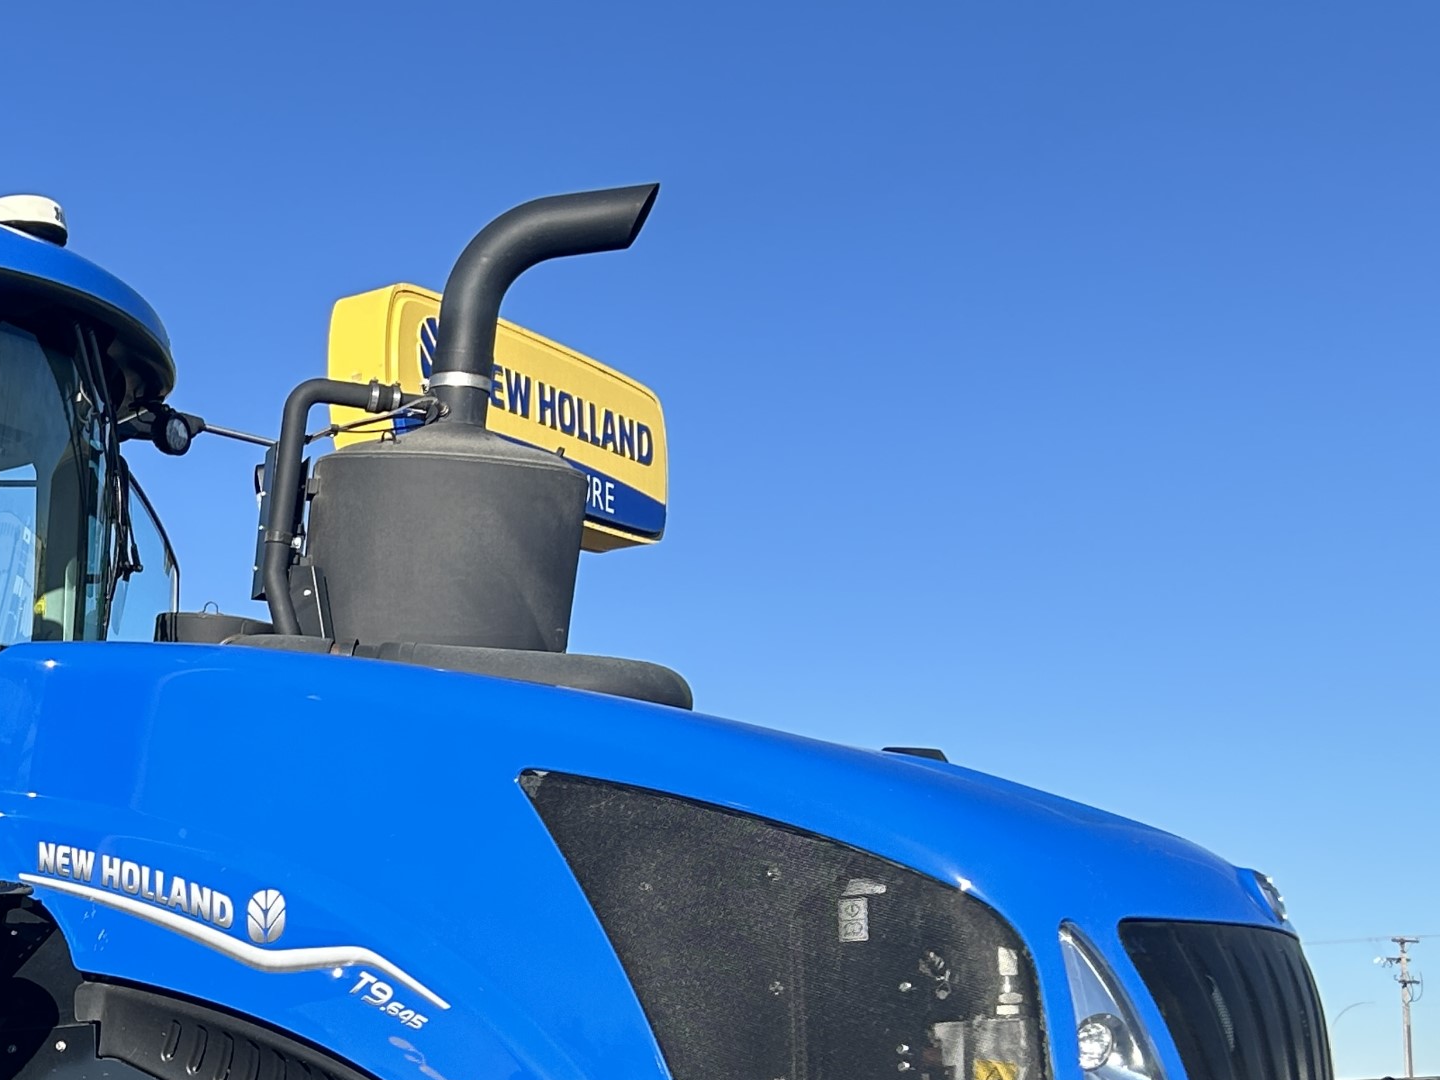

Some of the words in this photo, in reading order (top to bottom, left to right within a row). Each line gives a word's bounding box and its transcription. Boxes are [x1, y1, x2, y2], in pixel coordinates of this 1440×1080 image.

[490, 363, 531, 419] EW
[537, 380, 654, 467] HOLLAND
[38, 841, 95, 882] NEW
[101, 854, 234, 929] HOLLAND
